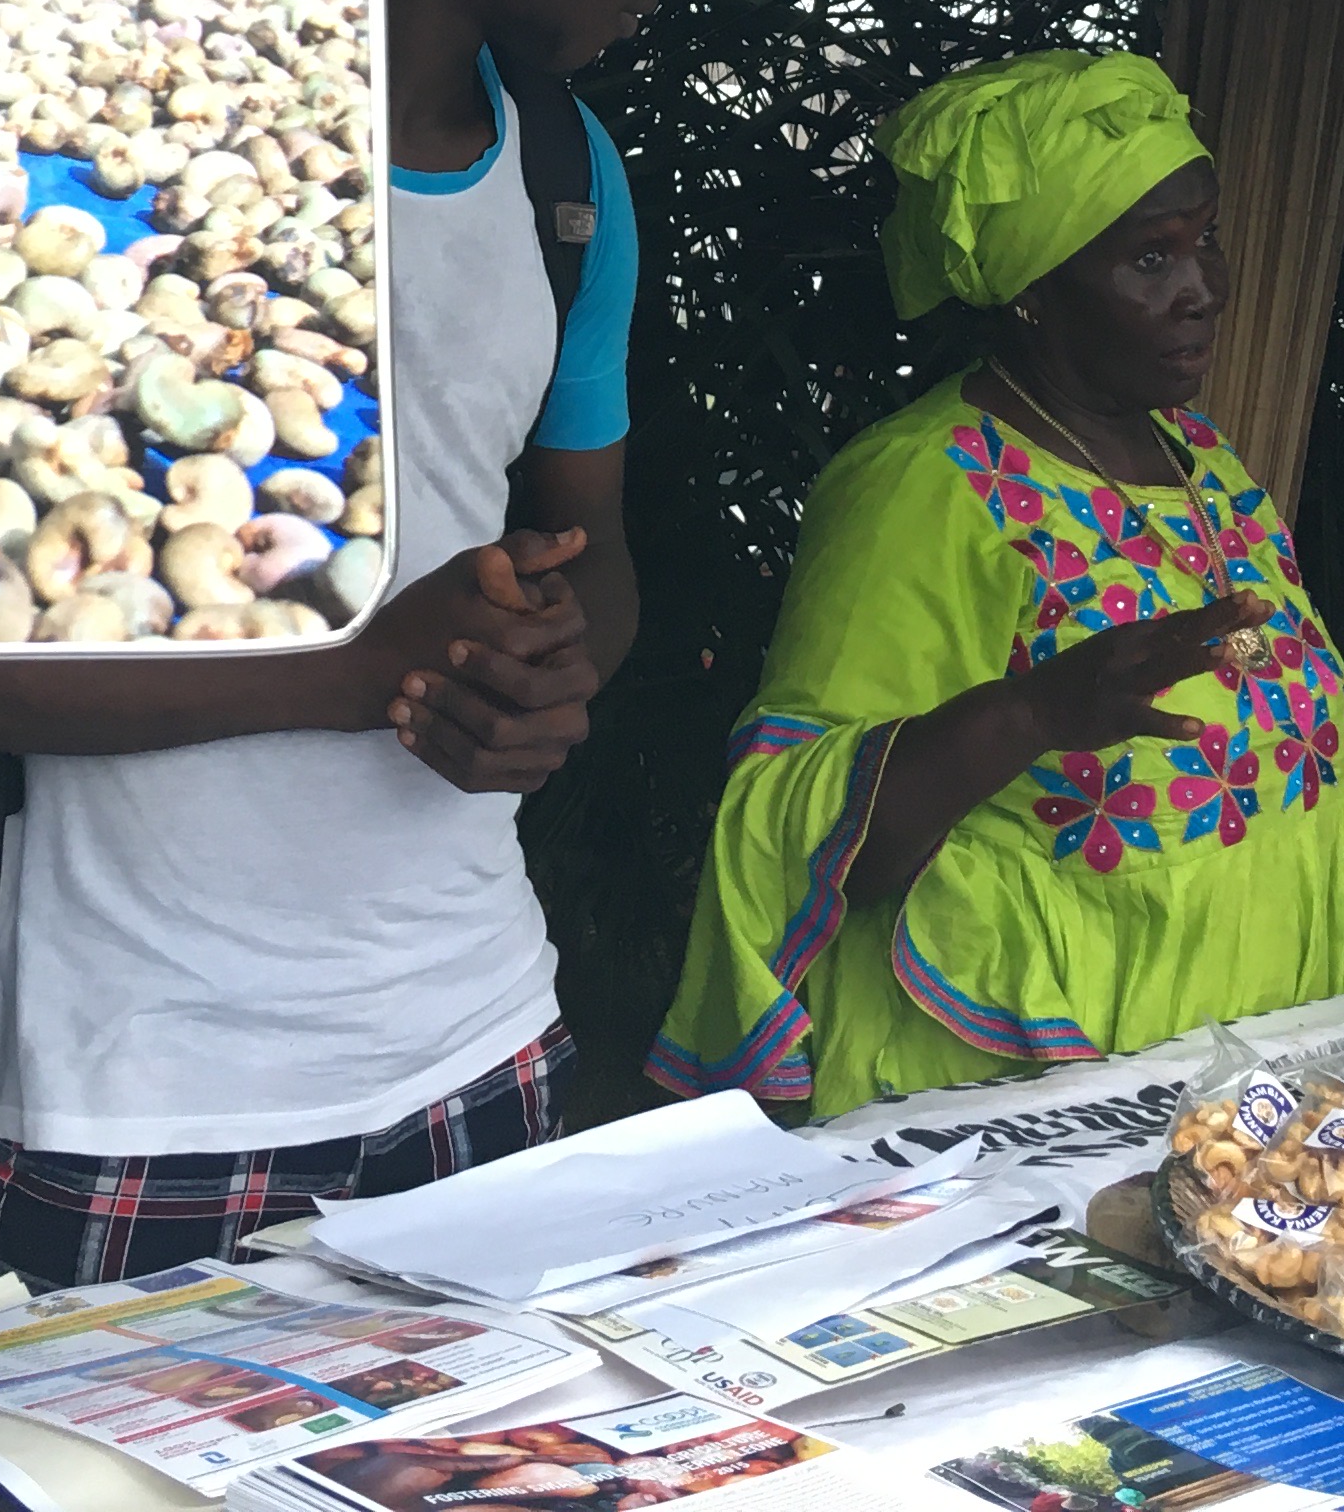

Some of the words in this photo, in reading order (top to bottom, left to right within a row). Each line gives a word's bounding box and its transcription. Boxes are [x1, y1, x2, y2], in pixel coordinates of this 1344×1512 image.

[1242, 1086, 1285, 1107] KAMBIA
[702, 1371, 764, 1406] USAID
[735, 1436, 788, 1461] LEONE
[424, 1483, 525, 1505] FOSTERING
[660, 1429, 772, 1467] AGRICULTURE
